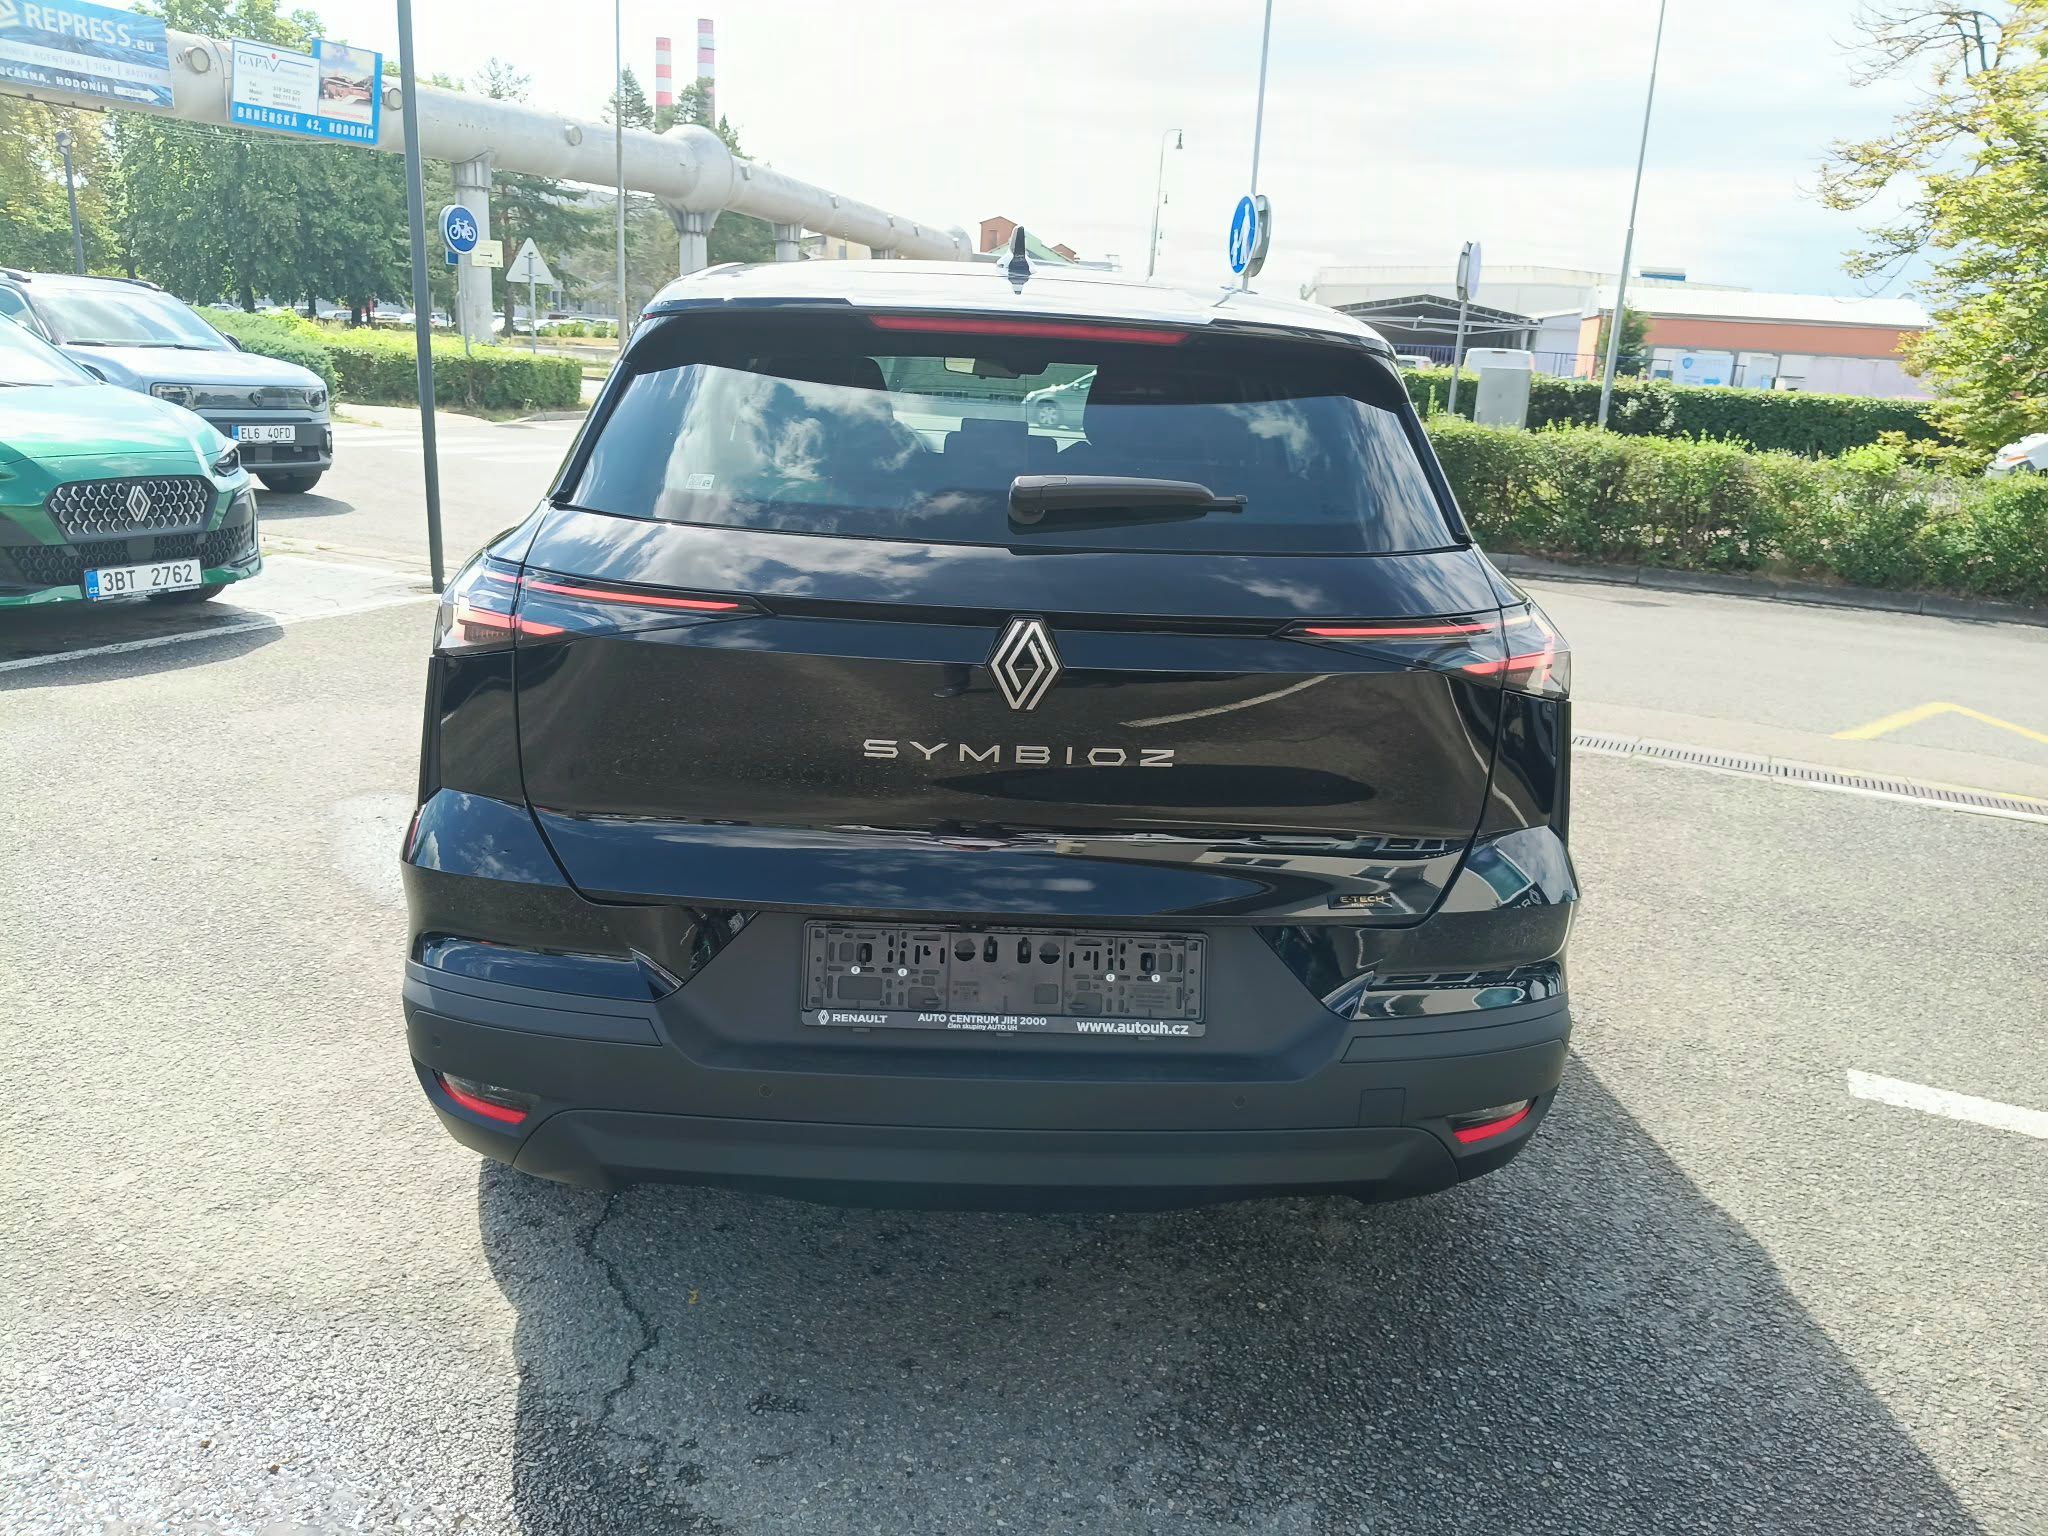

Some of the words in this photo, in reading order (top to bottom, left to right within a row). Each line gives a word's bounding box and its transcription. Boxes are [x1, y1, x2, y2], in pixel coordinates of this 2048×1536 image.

[24, 2, 155, 53] REPRESS.eu
[237, 106, 298, 128] BRNĚNSKÁ
[241, 427, 260, 439] EL6
[103, 569, 136, 592] 3BT
[151, 563, 193, 587] 2762
[863, 738, 1175, 768] SYMBIOZ
[1340, 895, 1385, 903] E-TECH
[832, 1013, 888, 1024] RENAULT
[918, 1013, 947, 1022] AUTO
[949, 1014, 999, 1024] CENTRUM
[1000, 1016, 1018, 1025] JIH
[1019, 1017, 1047, 1026] 2000
[1076, 1020, 1189, 1035] www.autouh.cz
